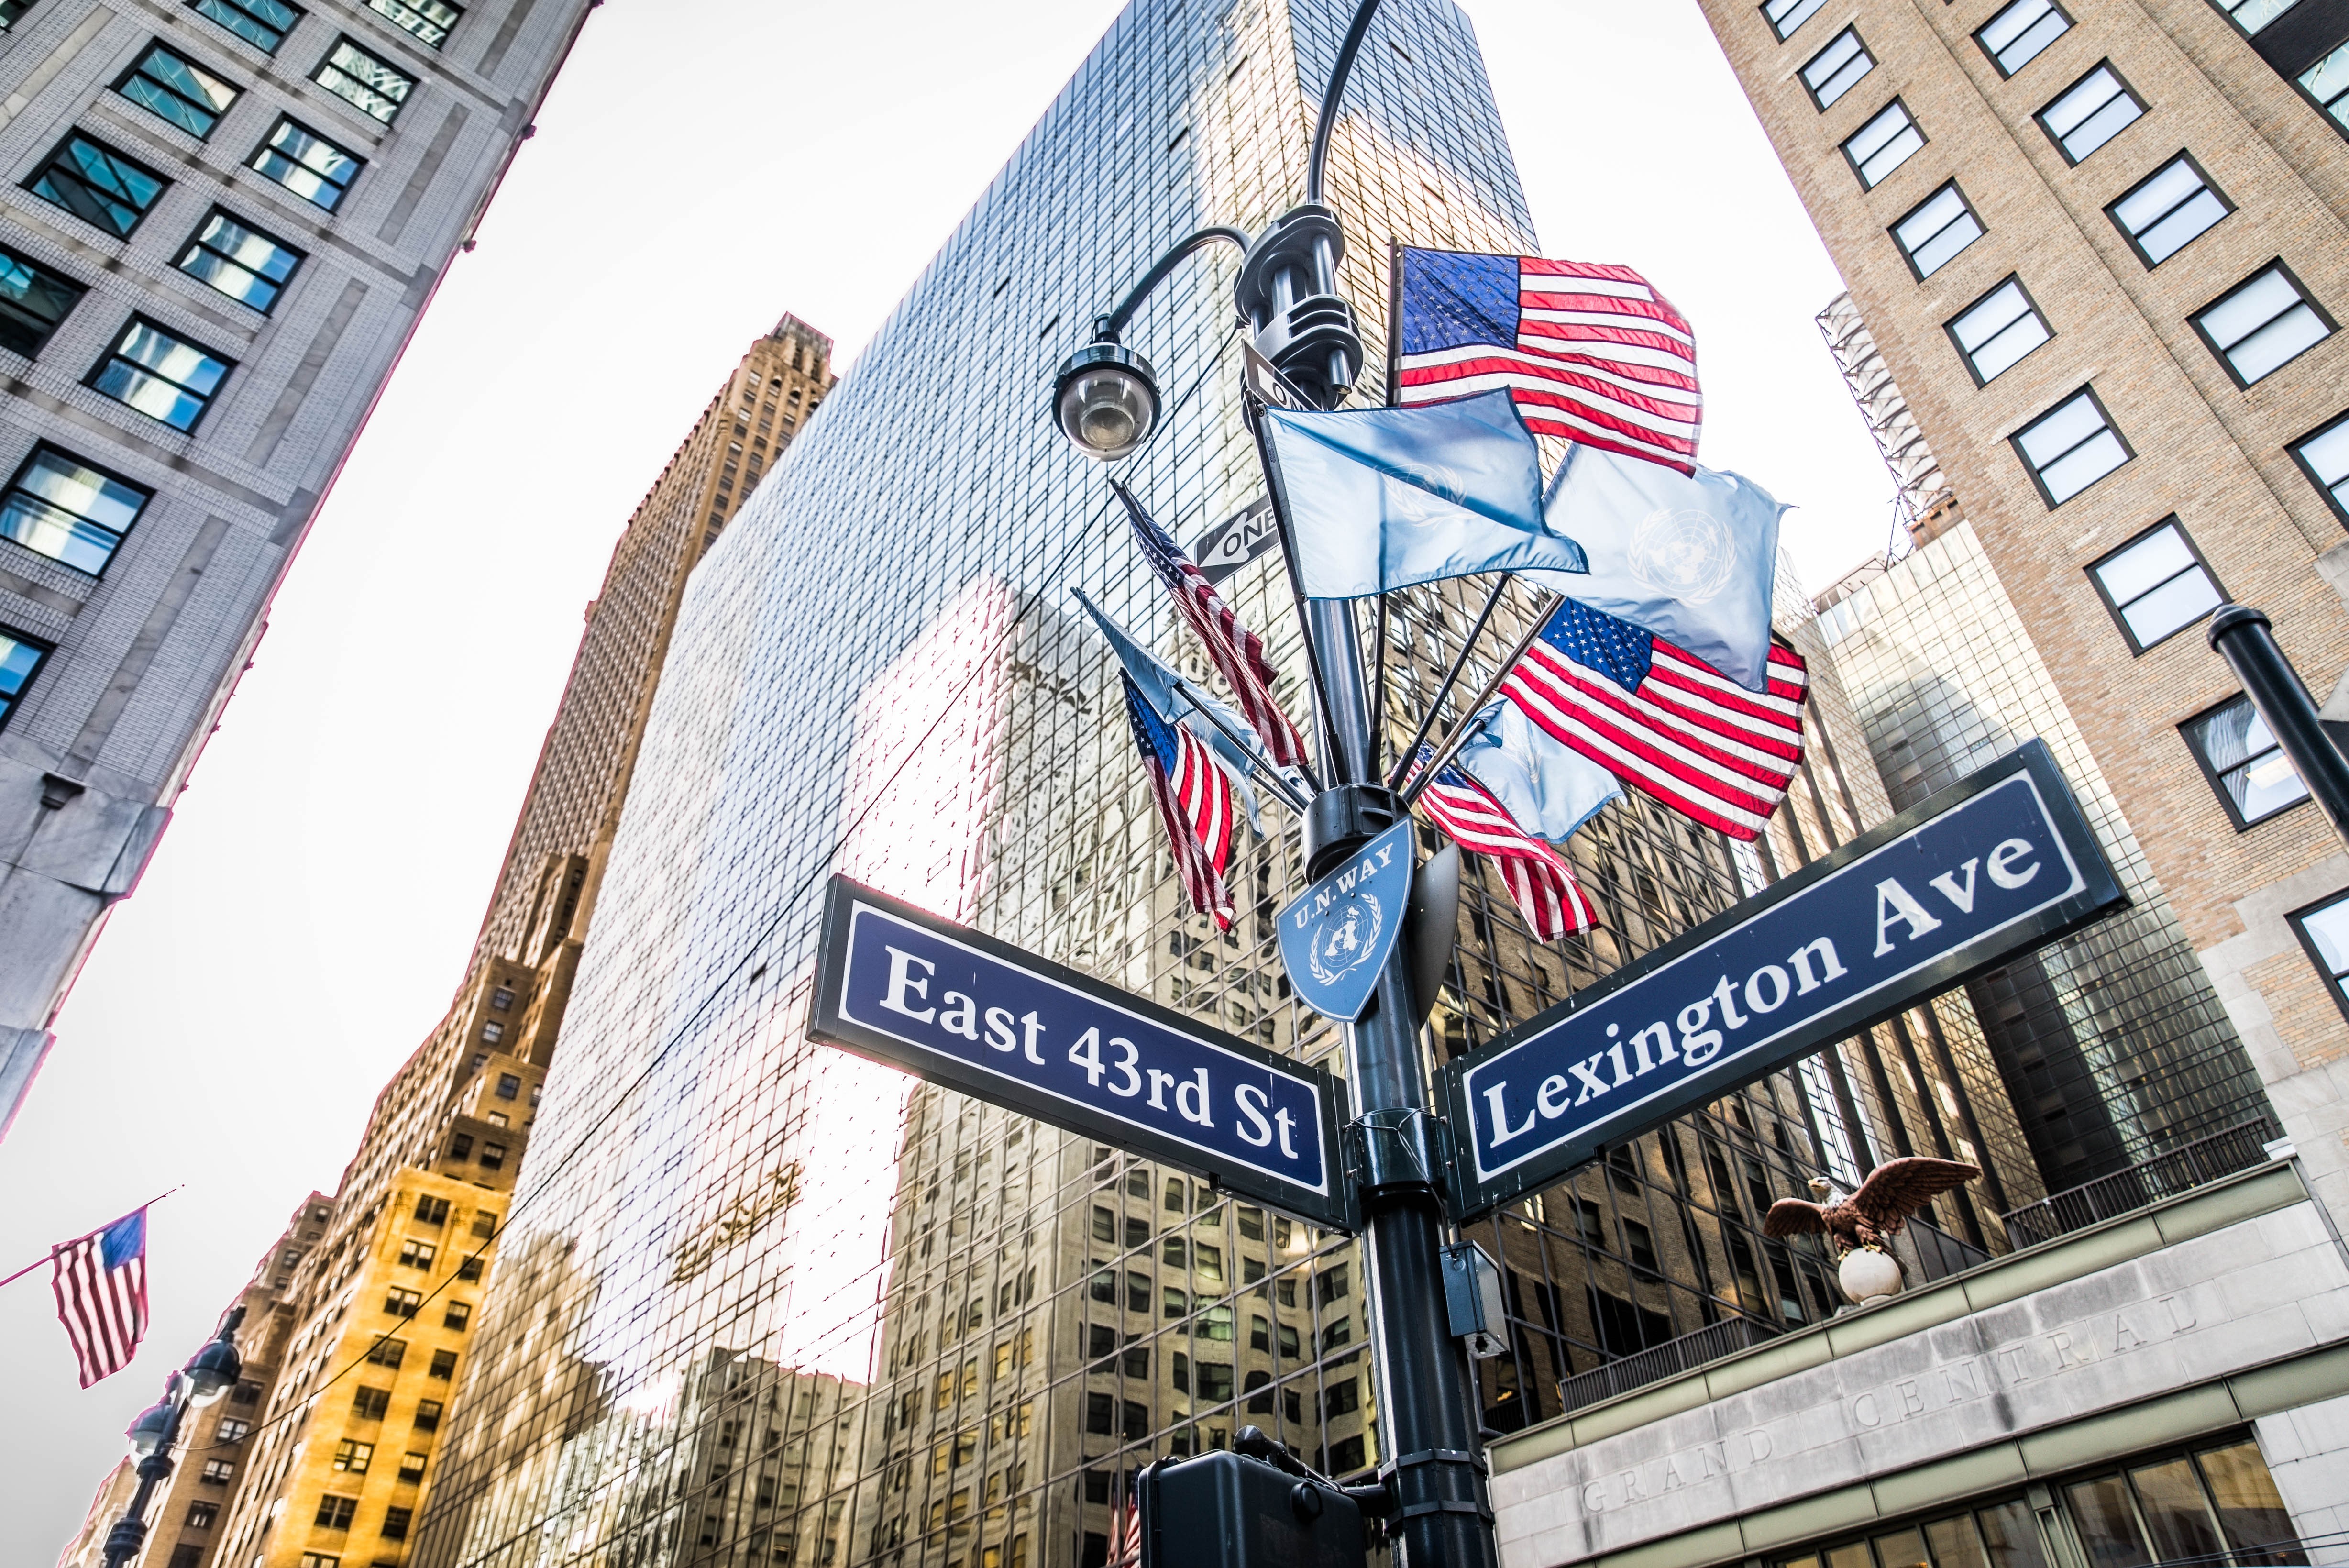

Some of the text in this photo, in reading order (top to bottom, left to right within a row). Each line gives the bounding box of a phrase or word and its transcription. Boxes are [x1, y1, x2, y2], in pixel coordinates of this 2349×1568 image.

[1223, 508, 1276, 557] ONE
[880, 945, 1298, 1159] East 43rd St
[1483, 839, 2040, 1148] Lexington Ave
[1582, 1296, 2197, 1513] GRAND CENTRAL
